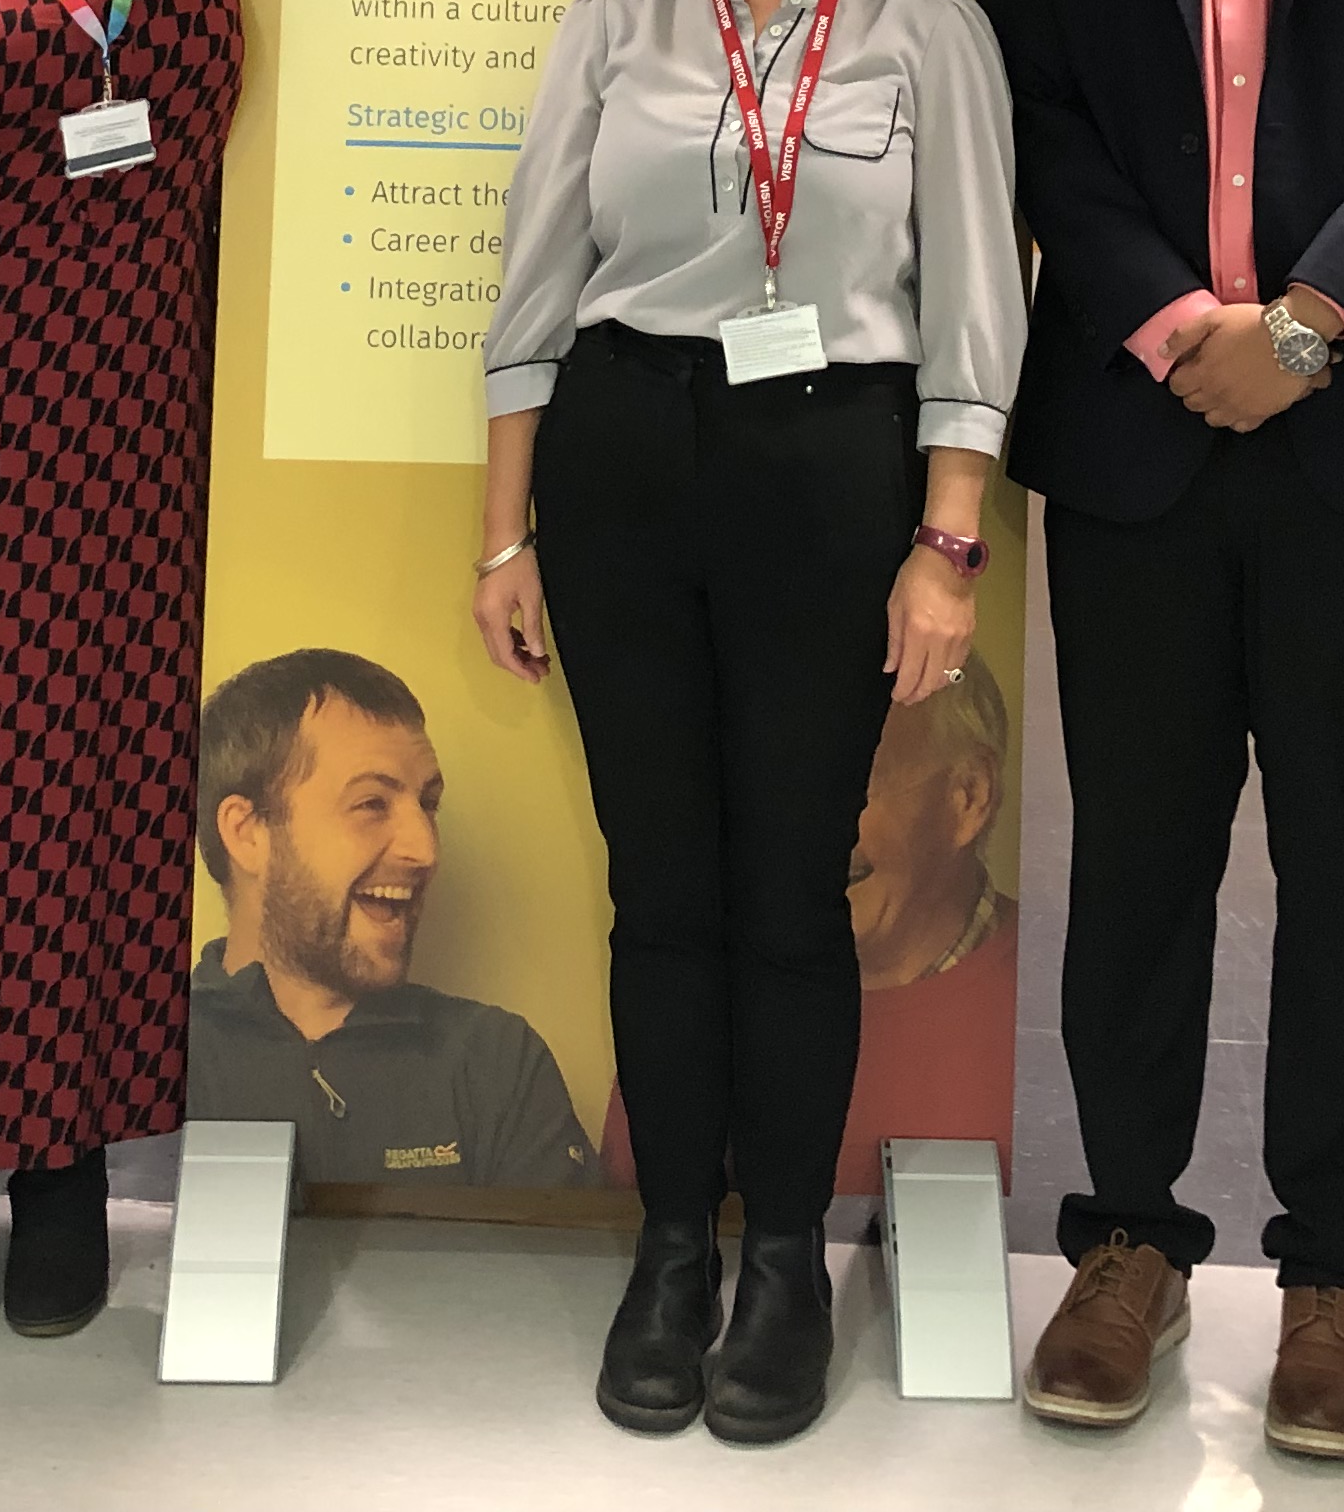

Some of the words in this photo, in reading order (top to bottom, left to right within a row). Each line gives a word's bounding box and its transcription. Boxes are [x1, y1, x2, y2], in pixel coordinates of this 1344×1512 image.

[445, 1, 461, 20] a
[810, 14, 830, 52] VISITOR
[350, 41, 477, 74] creativity
[485, 45, 536, 71] and
[730, 49, 749, 89] VISITOR
[793, 75, 813, 114] VISITOR
[347, 103, 470, 136] Strategic
[479, 105, 528, 136] Obj
[746, 108, 765, 150] VISITOR
[780, 135, 797, 183] VISITOR
[370, 180, 463, 206] Attract
[370, 227, 460, 253] Career
[469, 229, 503, 255] de
[369, 275, 502, 308] Integratio
